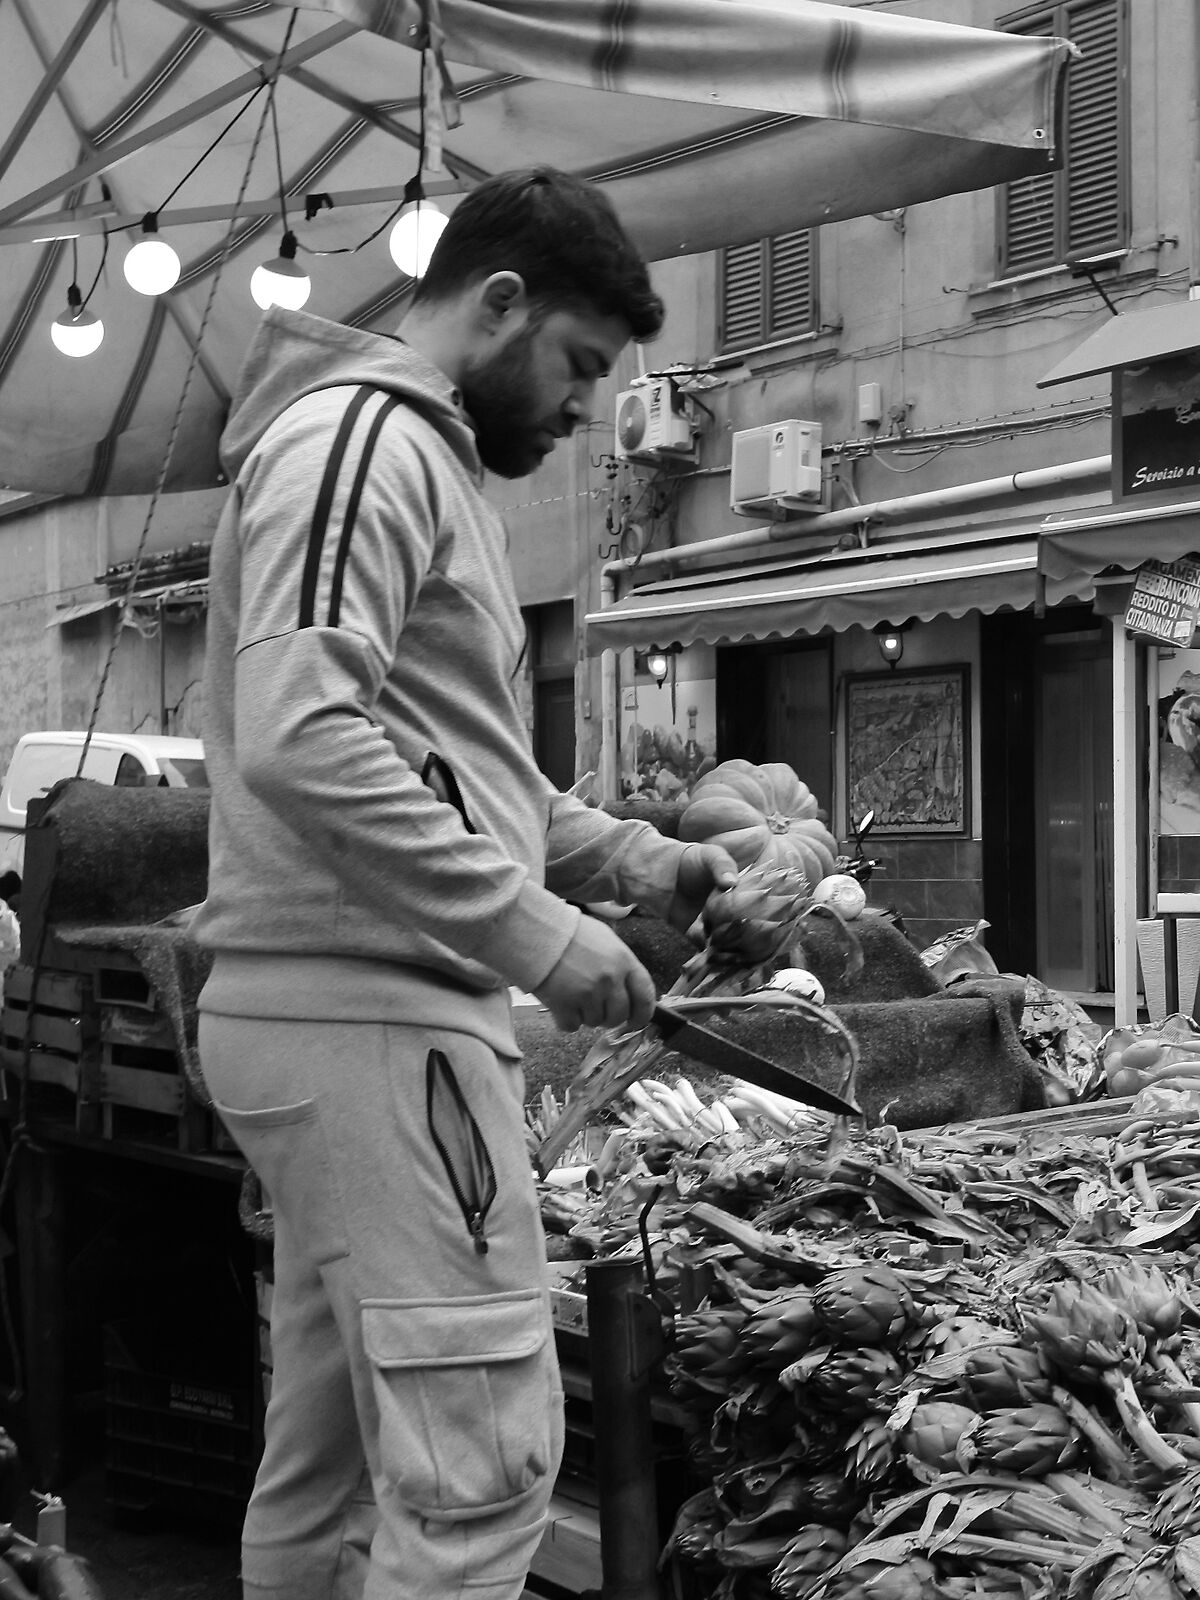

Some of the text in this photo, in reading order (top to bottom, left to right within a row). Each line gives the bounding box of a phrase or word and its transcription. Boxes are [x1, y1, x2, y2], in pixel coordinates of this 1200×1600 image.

[1132, 466, 1183, 488] Servizio
[1186, 467, 1195, 476] a
[1130, 591, 1169, 615] REDDITO
[1168, 603, 1180, 619] DI
[1125, 607, 1174, 638] CITTADINANZA
